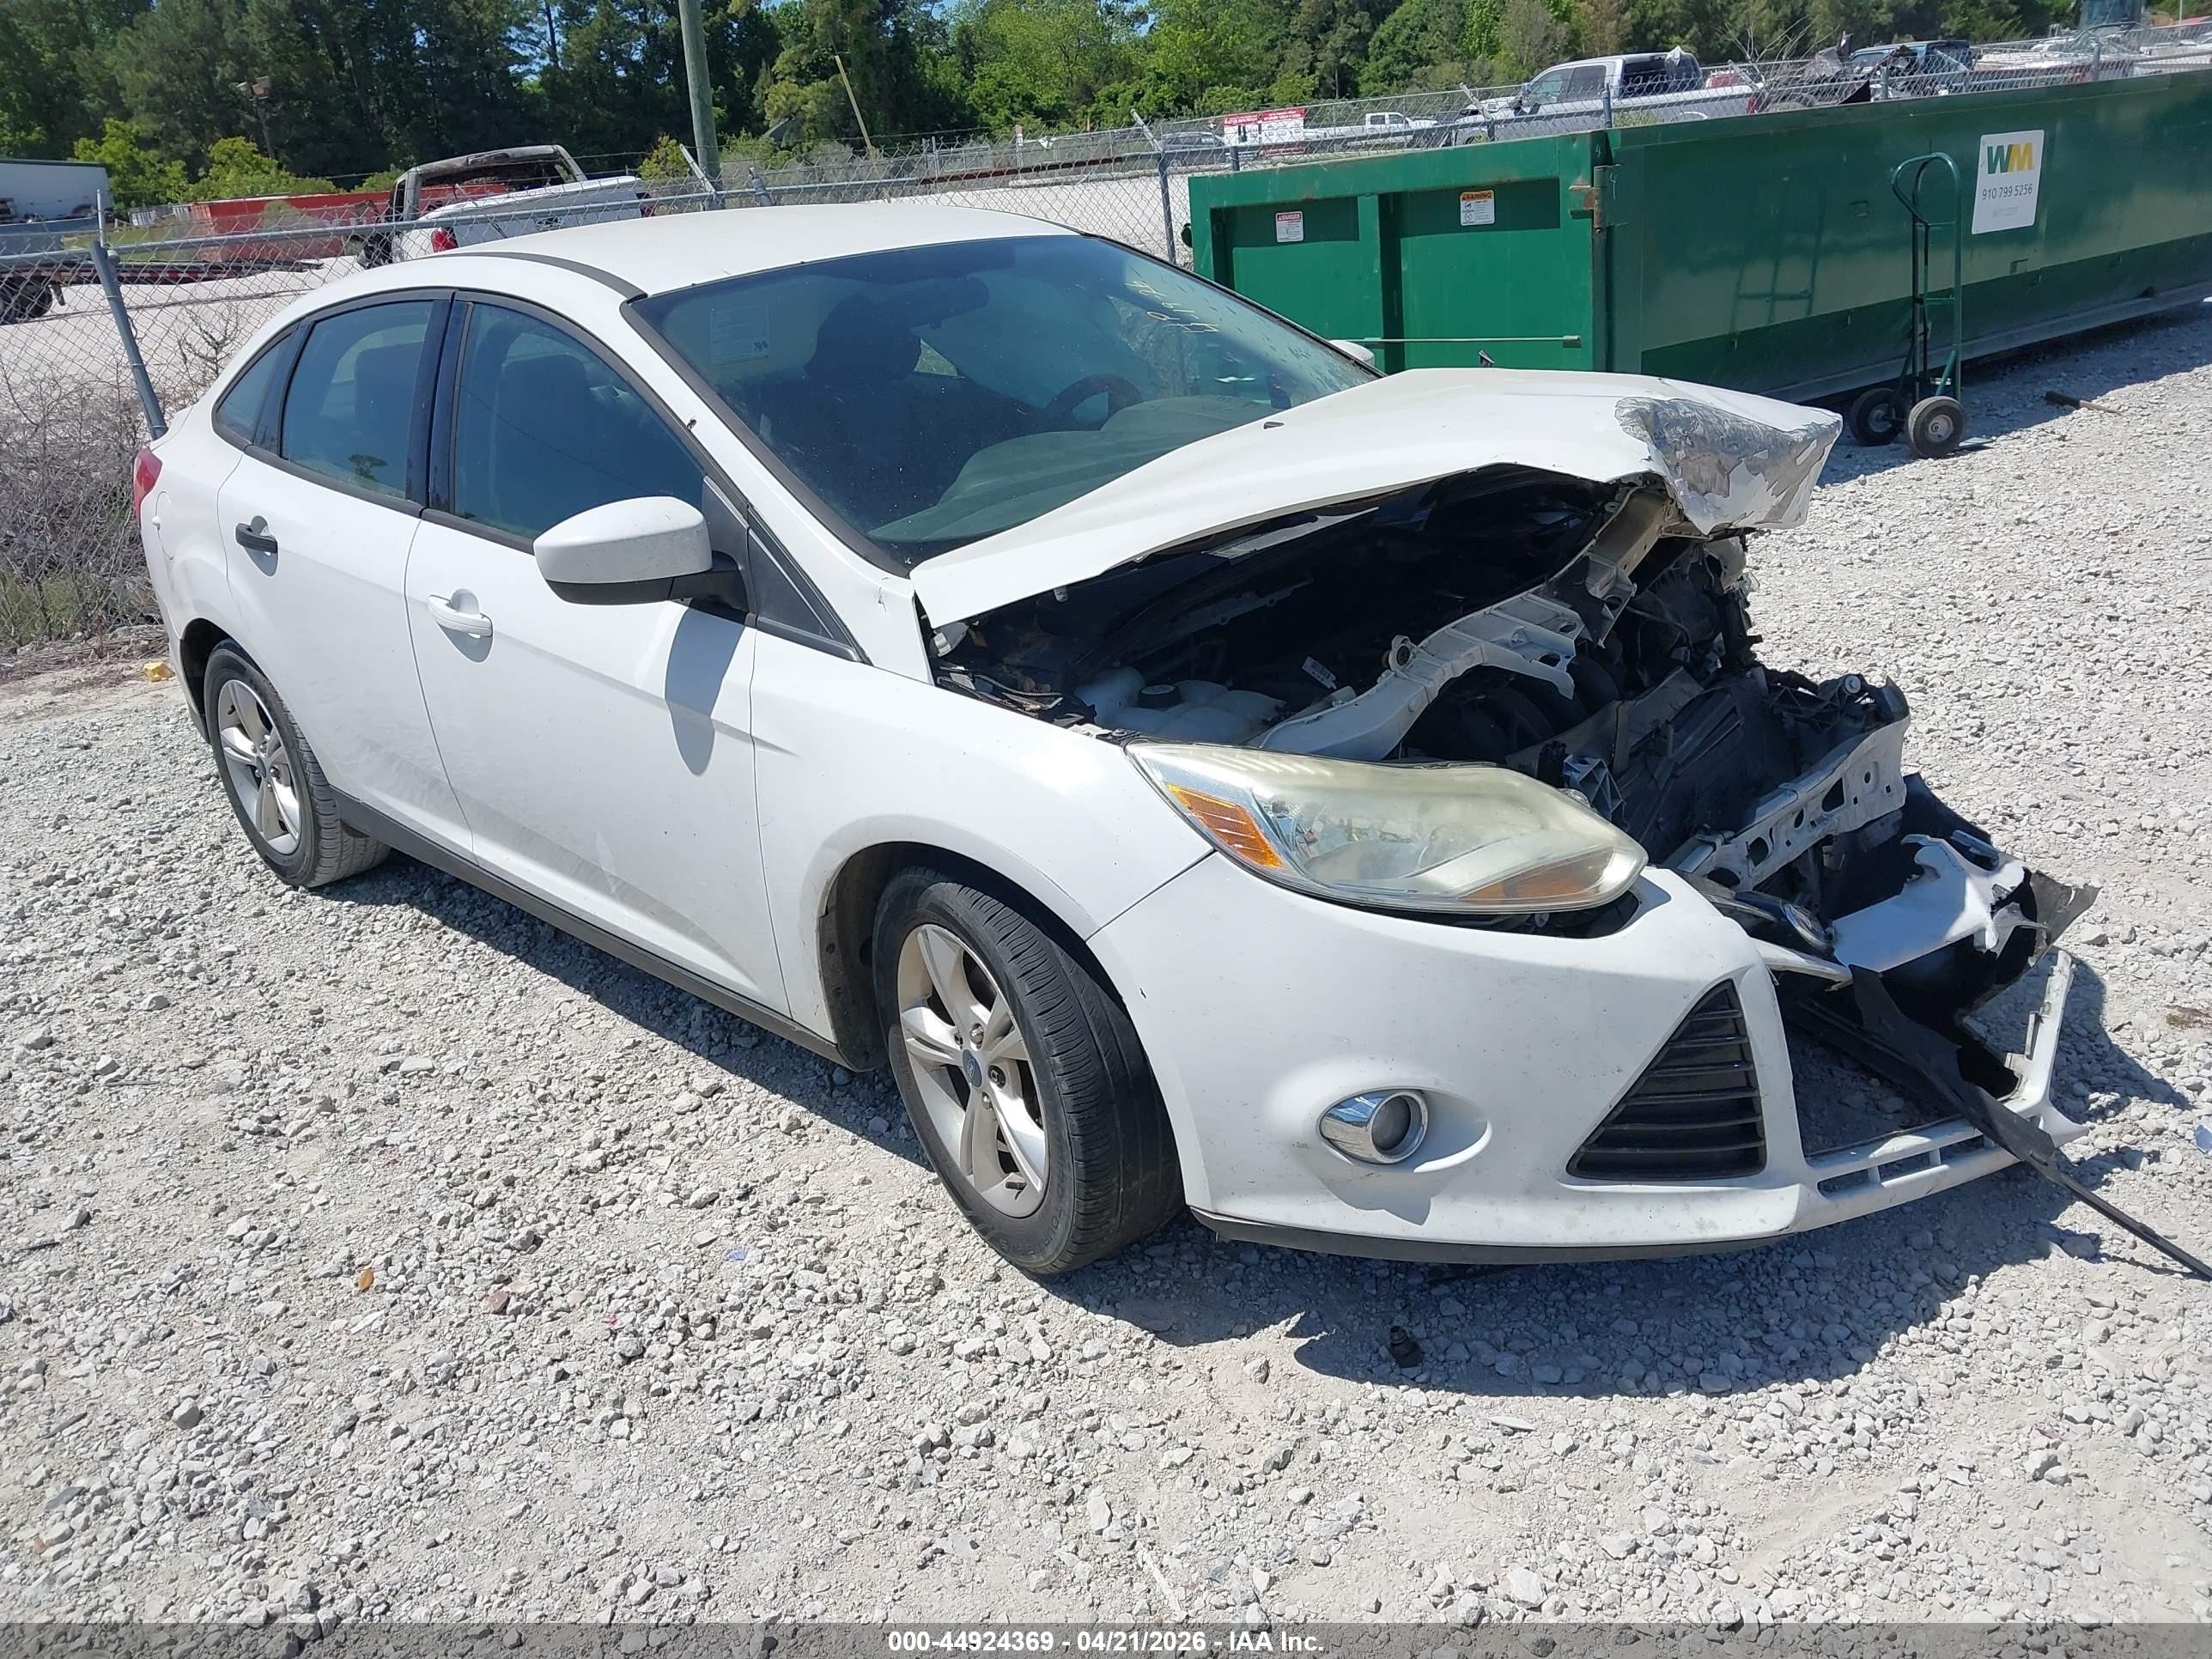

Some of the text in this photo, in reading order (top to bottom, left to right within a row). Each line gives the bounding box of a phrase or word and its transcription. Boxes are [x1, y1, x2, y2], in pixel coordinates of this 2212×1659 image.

[1986, 143, 2034, 174] WM
[1982, 184, 2033, 200] 910 799 5256
